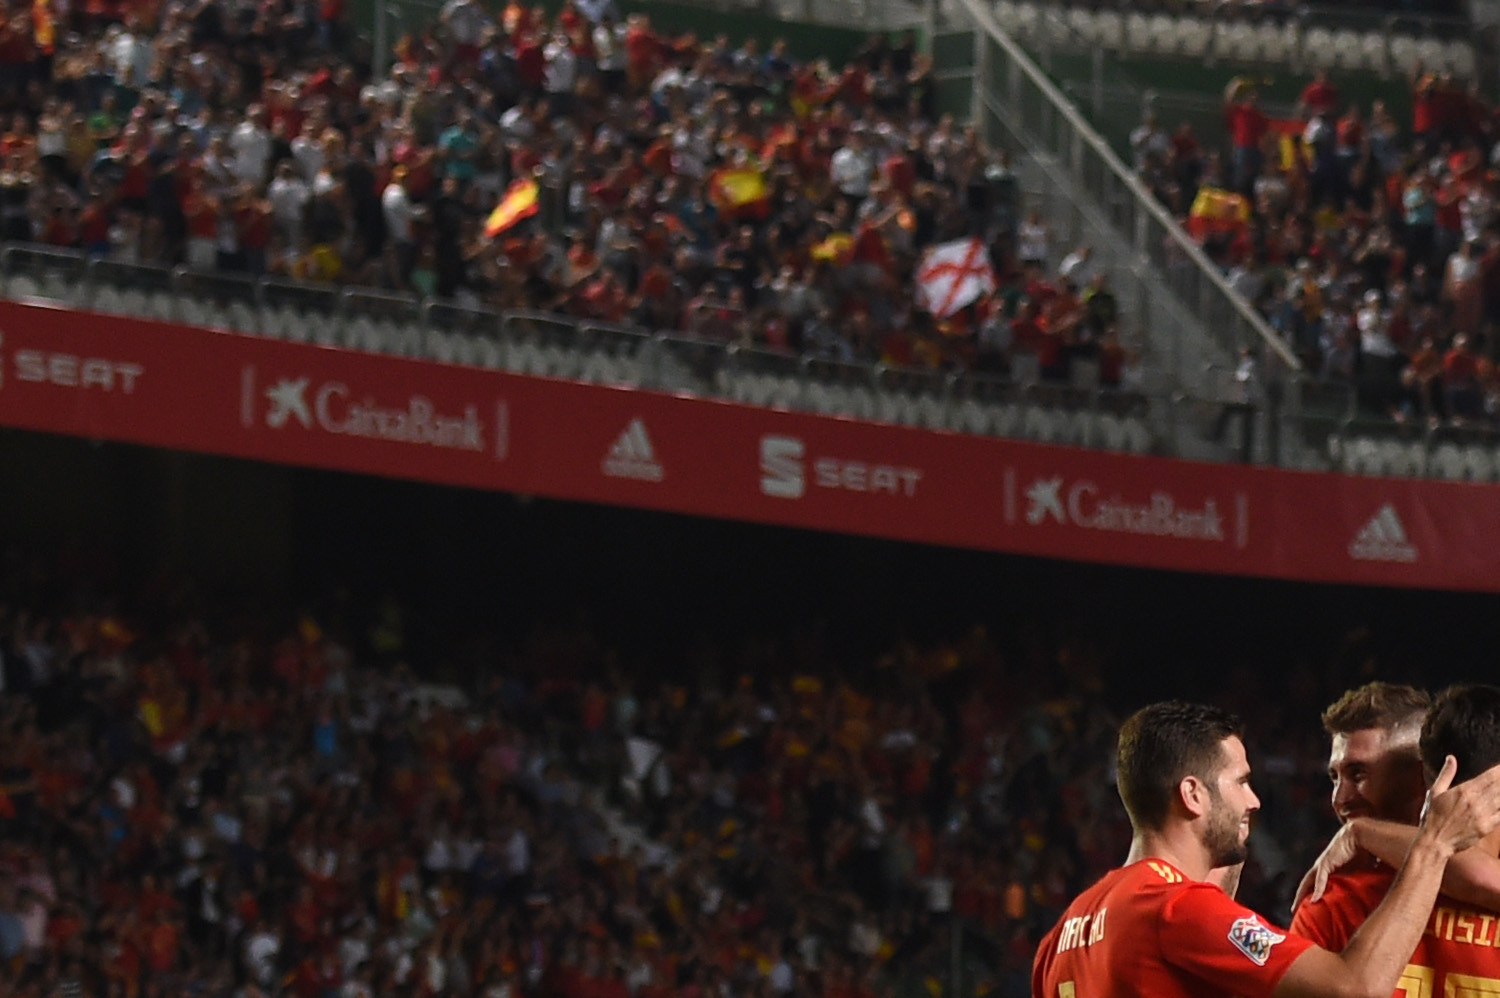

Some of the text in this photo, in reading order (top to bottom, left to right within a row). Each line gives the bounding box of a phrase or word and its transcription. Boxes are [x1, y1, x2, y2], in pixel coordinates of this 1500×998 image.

[15, 349, 144, 394] SEAT
[314, 381, 485, 451] CaixaBank
[814, 458, 922, 497] SEAT
[1068, 479, 1223, 541] CaixaBank
